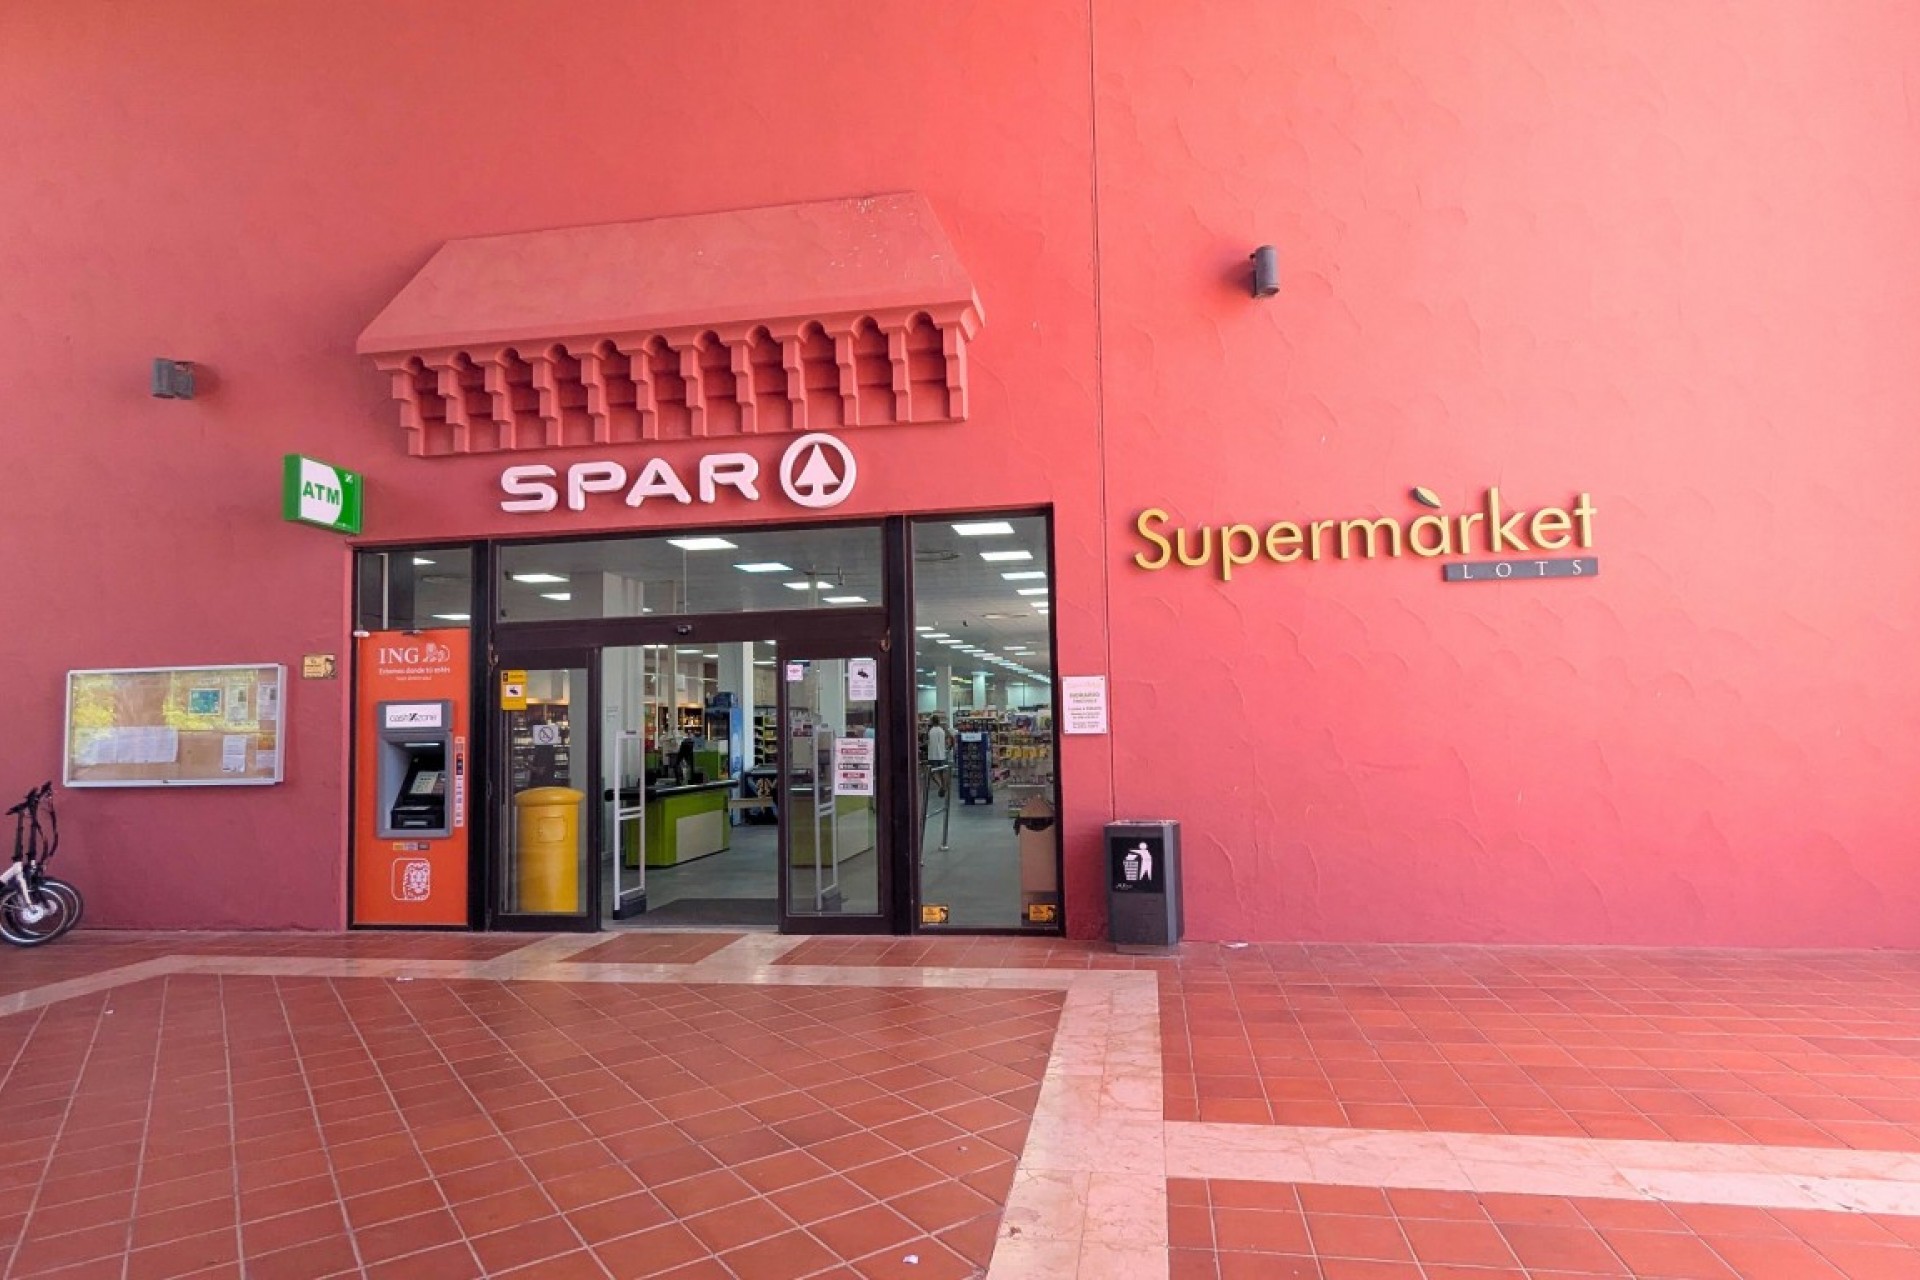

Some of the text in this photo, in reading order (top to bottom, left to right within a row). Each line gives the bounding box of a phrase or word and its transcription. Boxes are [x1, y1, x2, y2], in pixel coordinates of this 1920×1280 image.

[302, 480, 341, 506] ATM
[500, 452, 760, 513] SPAR
[1462, 559, 1583, 580] LOTS
[378, 646, 419, 665] ING
